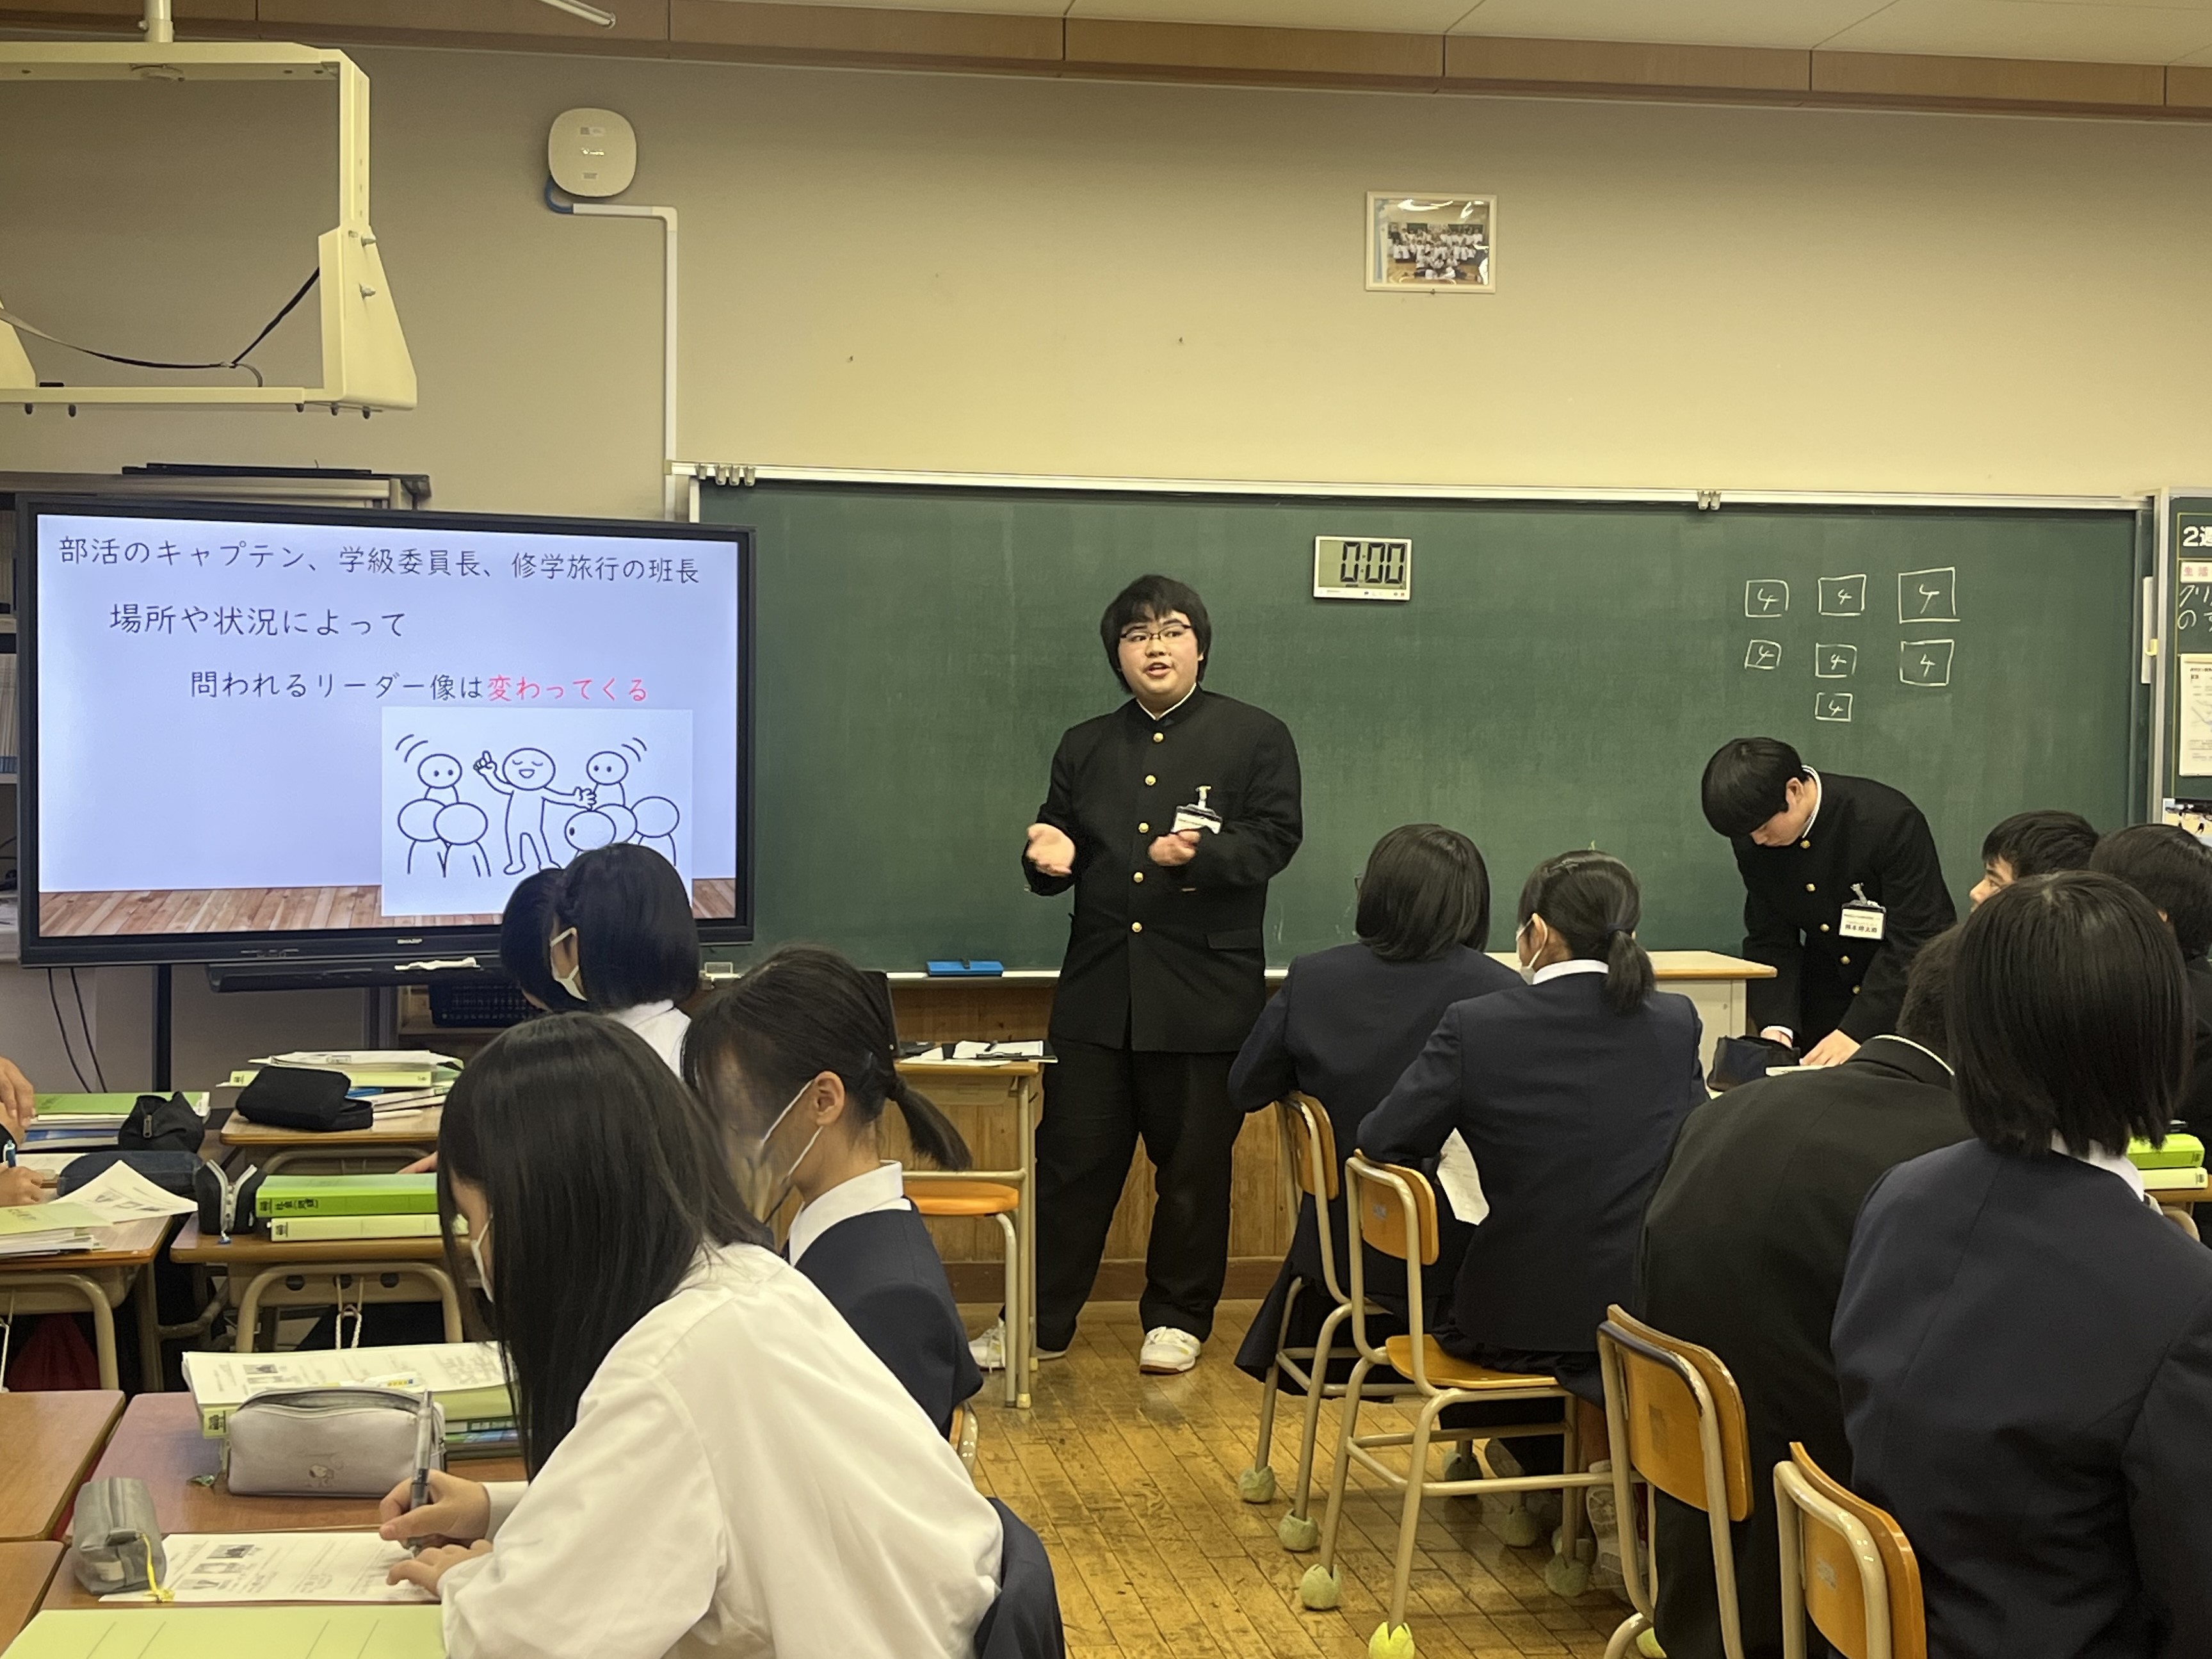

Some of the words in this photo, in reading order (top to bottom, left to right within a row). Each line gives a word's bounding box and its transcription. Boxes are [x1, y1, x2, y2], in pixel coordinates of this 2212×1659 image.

[59, 536, 700, 583] 部活のキャプテン、学級委員長、修学旅行の班長
[1757, 588, 1779, 611] 4
[1837, 588, 1852, 605] 4
[1919, 584, 1941, 614] 4
[109, 603, 405, 636] 場所や状況によって
[1758, 645, 1775, 665] 4
[1830, 654, 1847, 670] 4
[1920, 654, 1935, 677] 4
[191, 670, 647, 702] 問われるリーダー像は変わってくる
[1829, 699, 1845, 717] 4
